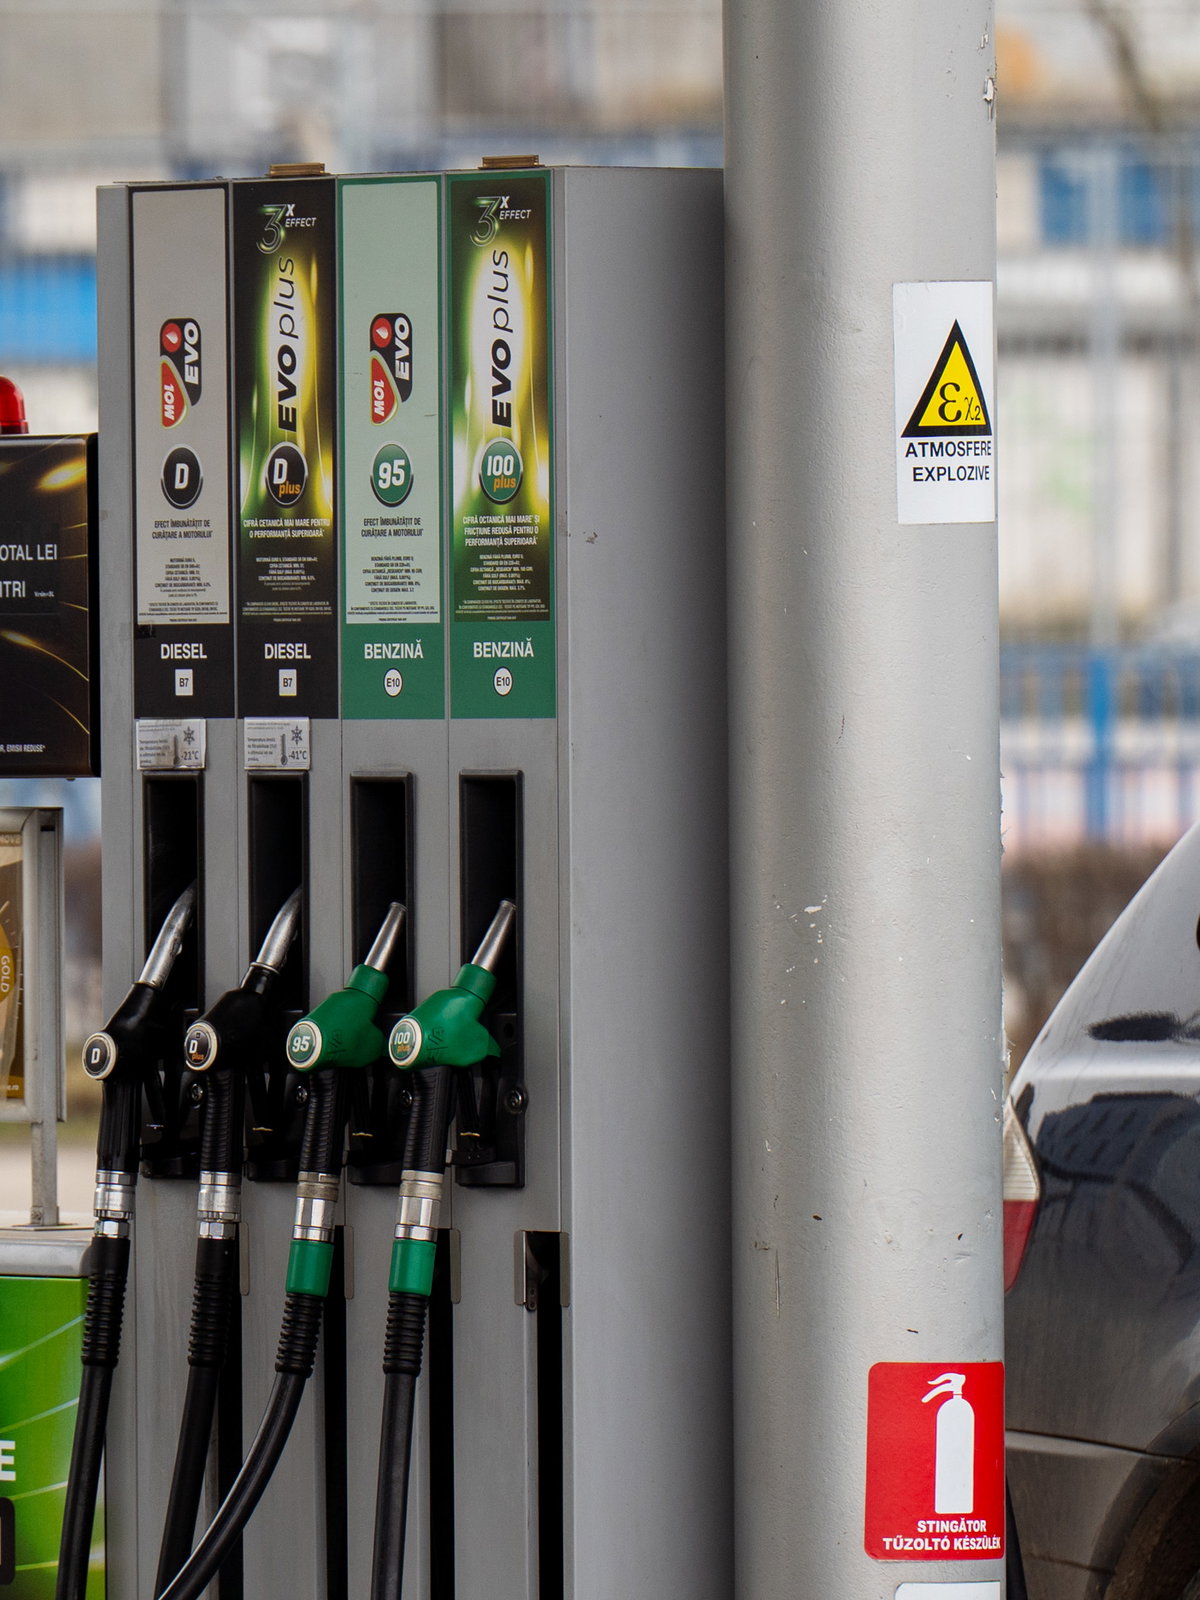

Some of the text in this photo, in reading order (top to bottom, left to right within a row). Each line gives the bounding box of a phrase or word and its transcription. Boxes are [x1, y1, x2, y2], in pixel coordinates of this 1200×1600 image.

[285, 217, 317, 228] EFFECT
[499, 209, 532, 220] EFFECT
[183, 321, 200, 385] EVO
[394, 317, 410, 381] EVO
[163, 383, 175, 421] MOL
[373, 379, 385, 417] MOL
[905, 440, 991, 458] ATMOSFERE
[273, 458, 288, 485] D
[487, 454, 514, 477] 100
[913, 465, 990, 482] EXPLOZIVE
[174, 463, 189, 490] D
[378, 459, 405, 489] 95
[278, 481, 300, 498] plus
[493, 474, 516, 492] plus
[154, 520, 170, 529] EFECT
[204, 519, 210, 527] DE
[284, 519, 294, 527] MAI
[295, 518, 310, 527] MARE
[363, 518, 379, 527] EFECT
[414, 517, 421, 525] DE
[505, 515, 516, 523] MAI
[388, 528, 393, 537] A
[513, 525, 534, 535] PENTRU
[37, 544, 58, 560] LEI
[161, 643, 207, 659] DIESEL
[264, 643, 311, 659] DIESEL
[364, 639, 424, 659] BENZINĂ
[473, 637, 534, 658] BENZINĂ
[179, 677, 189, 687] B7
[283, 677, 293, 687] B7
[386, 677, 400, 688] E10
[496, 676, 510, 687] E10
[1, 955, 11, 993] GOLD
[292, 1035, 311, 1052] 95
[394, 1031, 411, 1045] 100
[189, 1040, 198, 1053] D
[91, 1048, 100, 1064] D
[917, 1517, 987, 1533] STINGĂTOR
[883, 1534, 1002, 1551] TŰZOLTÓ KÉSZÜLÉK
